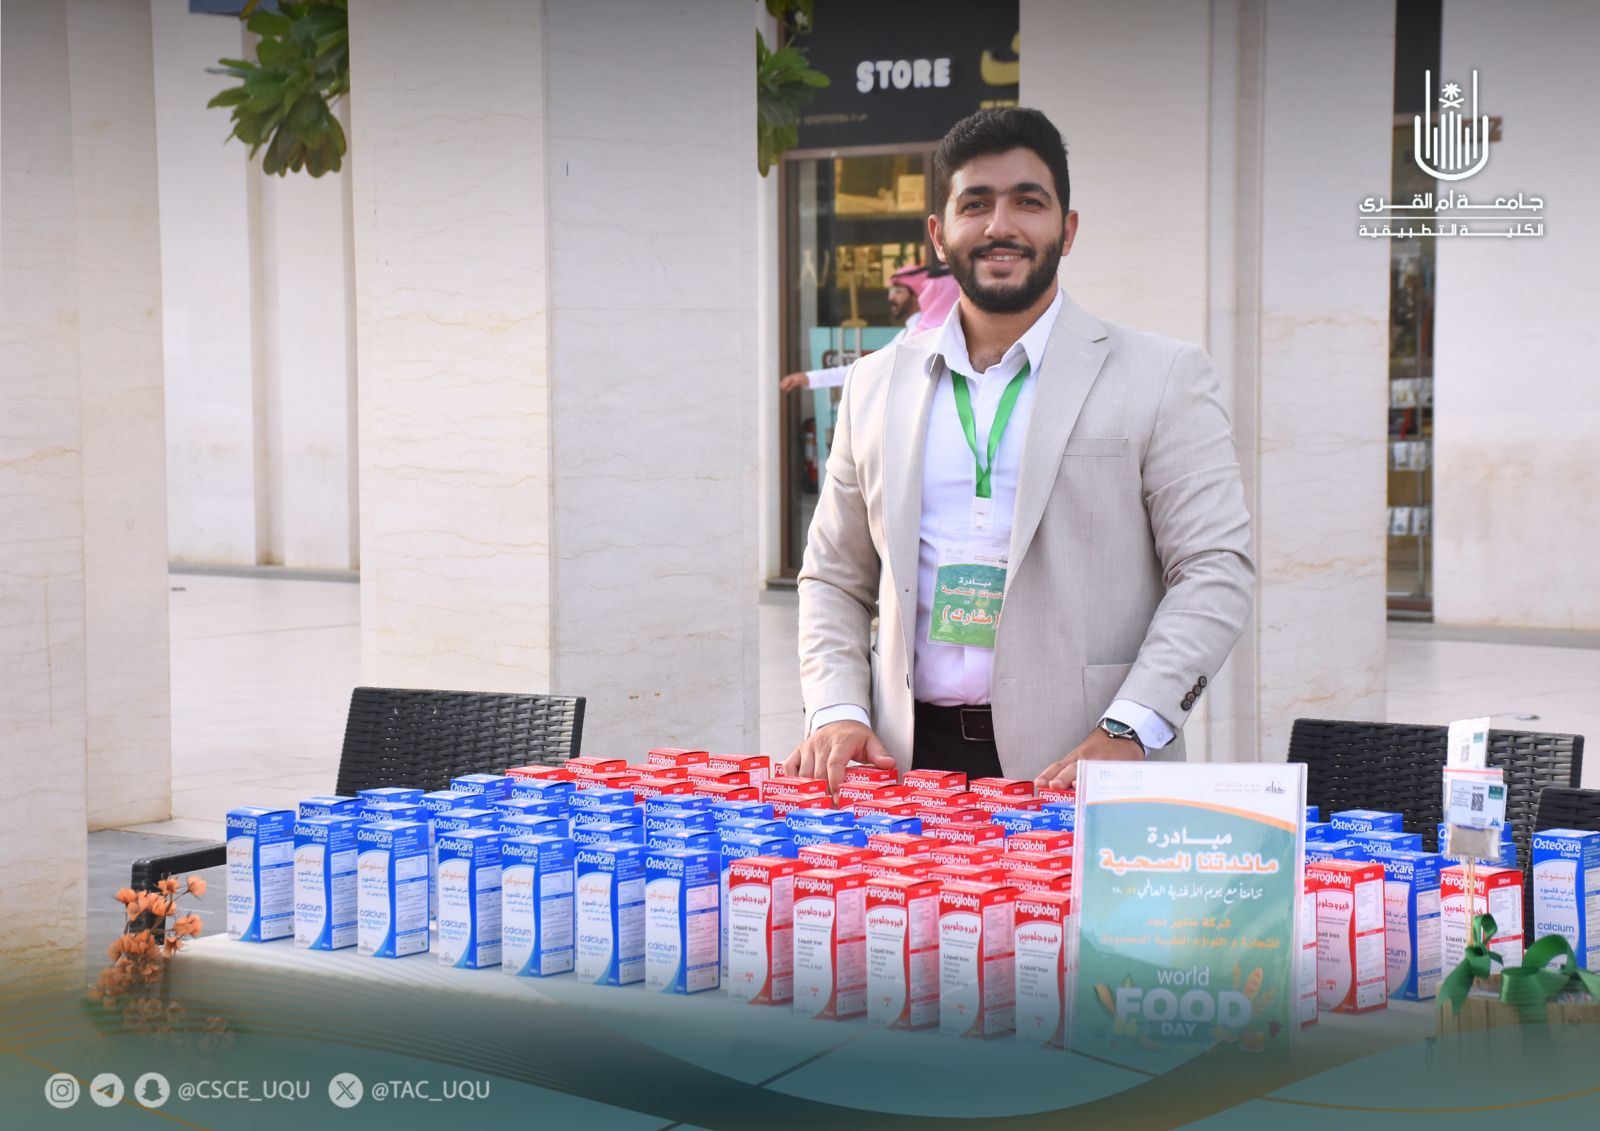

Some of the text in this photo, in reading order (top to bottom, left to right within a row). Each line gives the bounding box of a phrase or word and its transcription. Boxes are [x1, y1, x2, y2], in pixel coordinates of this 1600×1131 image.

[856, 57, 951, 93] STORE
[903, 778, 940, 790] Feroglobin
[839, 789, 874, 801] Feroglobin
[970, 786, 1003, 797] Feroglobin
[226, 816, 257, 829] Osteocare
[435, 818, 470, 830] Osteocare
[1331, 819, 1373, 832] Osteocare
[294, 824, 328, 838] Osteocare
[357, 830, 393, 844] Osteocare
[936, 829, 975, 844] Feroglobin
[1147, 826, 1233, 849] مبادرة
[438, 838, 474, 852] Osteocare
[502, 843, 538, 858] Osteocare
[721, 844, 759, 857] Osteocare
[867, 840, 905, 856] Feroglobin
[1008, 839, 1047, 852] Feroglobin
[1533, 838, 1582, 853] Osteocare
[577, 851, 616, 865] Osteocare
[799, 852, 838, 868] Feroglobin
[1561, 850, 1581, 858] Liquid
[646, 857, 684, 871] Osteocare
[1099, 848, 1279, 875] مائدتنا الصحية
[729, 864, 769, 881] Feroglobin
[1394, 873, 1414, 881] Liquid
[794, 877, 834, 894] Feroglobin
[866, 885, 905, 902] Feroglobin
[939, 892, 980, 908] Feroglobin
[1204, 885, 1223, 902] يوم
[1223, 887, 1238, 904] مع
[1015, 900, 1060, 918] Feroglobin
[1537, 921, 1575, 934] calcium
[580, 935, 609, 945] calcium
[648, 941, 678, 951] calcium
[1386, 946, 1407, 957] cium
[1157, 966, 1210, 986] world
[1116, 988, 1253, 1027] FOOD
[1161, 1022, 1197, 1037] DAY
